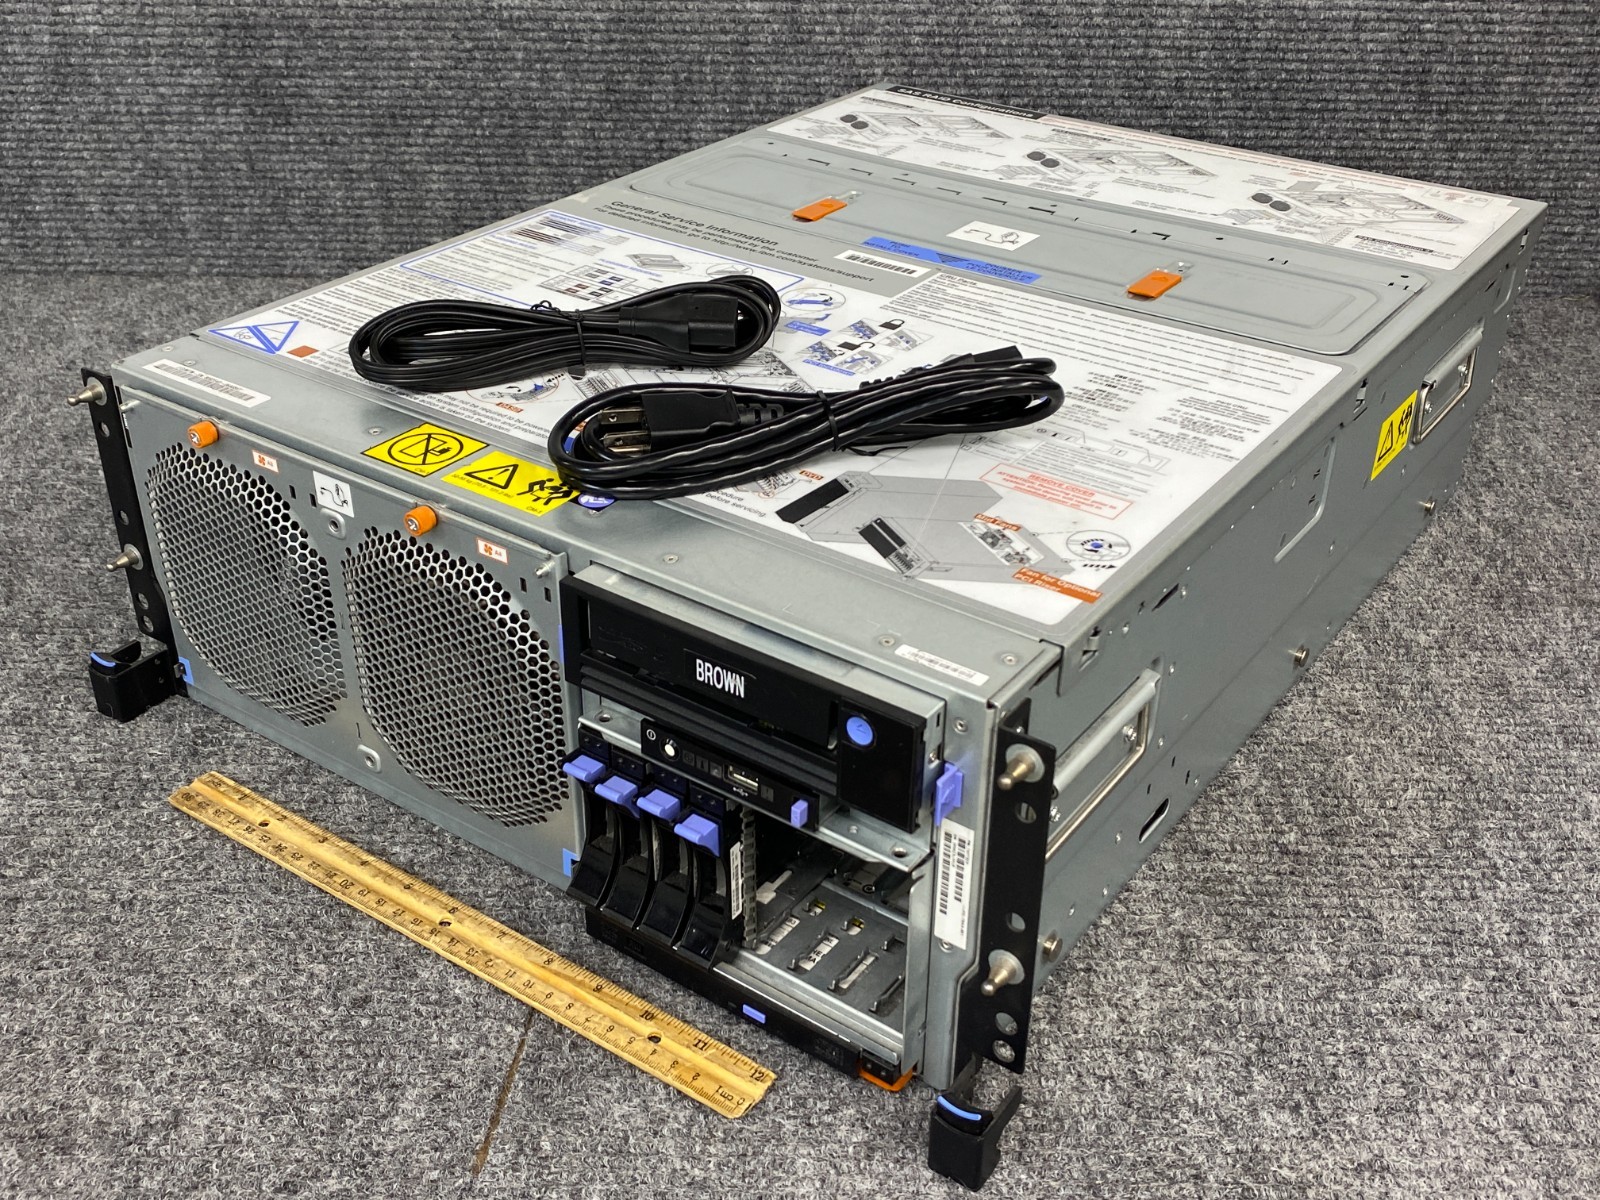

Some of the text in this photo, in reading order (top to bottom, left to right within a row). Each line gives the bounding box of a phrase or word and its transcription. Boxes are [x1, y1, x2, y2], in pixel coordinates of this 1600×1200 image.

[897, 88, 1035, 118] SAS RAID Configurations
[610, 200, 781, 245] General Service Information
[601, 204, 627, 212] These
[624, 211, 673, 224] procedures
[702, 231, 748, 244] performed
[775, 249, 819, 262] customer
[606, 211, 642, 221] detailed
[639, 220, 689, 234] information
[708, 238, 876, 282] http://www.ibm.com/systems/support
[1028, 474, 1094, 497] REMOVE COVER
[705, 493, 731, 504] before
[976, 513, 1019, 531] Mid Fans
[1014, 572, 1061, 592] PCI Riser
[1020, 567, 1100, 598] Fan for Optional
[695, 657, 747, 699] BROWN
[243, 825, 257, 835] 26
[259, 833, 272, 844] 25
[290, 851, 305, 862] 23
[307, 860, 321, 871] 22
[340, 879, 356, 890] 20
[357, 888, 371, 897] 19
[375, 897, 388, 907] 18
[392, 907, 406, 917] 17
[410, 917, 424, 927] 16
[429, 926, 441, 938] 15
[465, 946, 479, 958] 13
[484, 957, 494, 969] 12
[504, 968, 517, 979] 11
[522, 978, 535, 990] 10
[545, 991, 554, 1000] 9
[495, 930, 508, 940] 7
[542, 957, 555, 966] 8
[592, 984, 603, 994] 9
[638, 1009, 655, 1022] 10
[692, 1038, 709, 1052] 11
[750, 1068, 766, 1082] 12
[565, 1002, 575, 1011] 8
[606, 1024, 616, 1033] 6
[627, 1036, 636, 1045] 5
[650, 1048, 658, 1056] 4
[670, 1060, 679, 1069] 3
[692, 1072, 701, 1081] 2
[719, 1091, 734, 1102] cm
